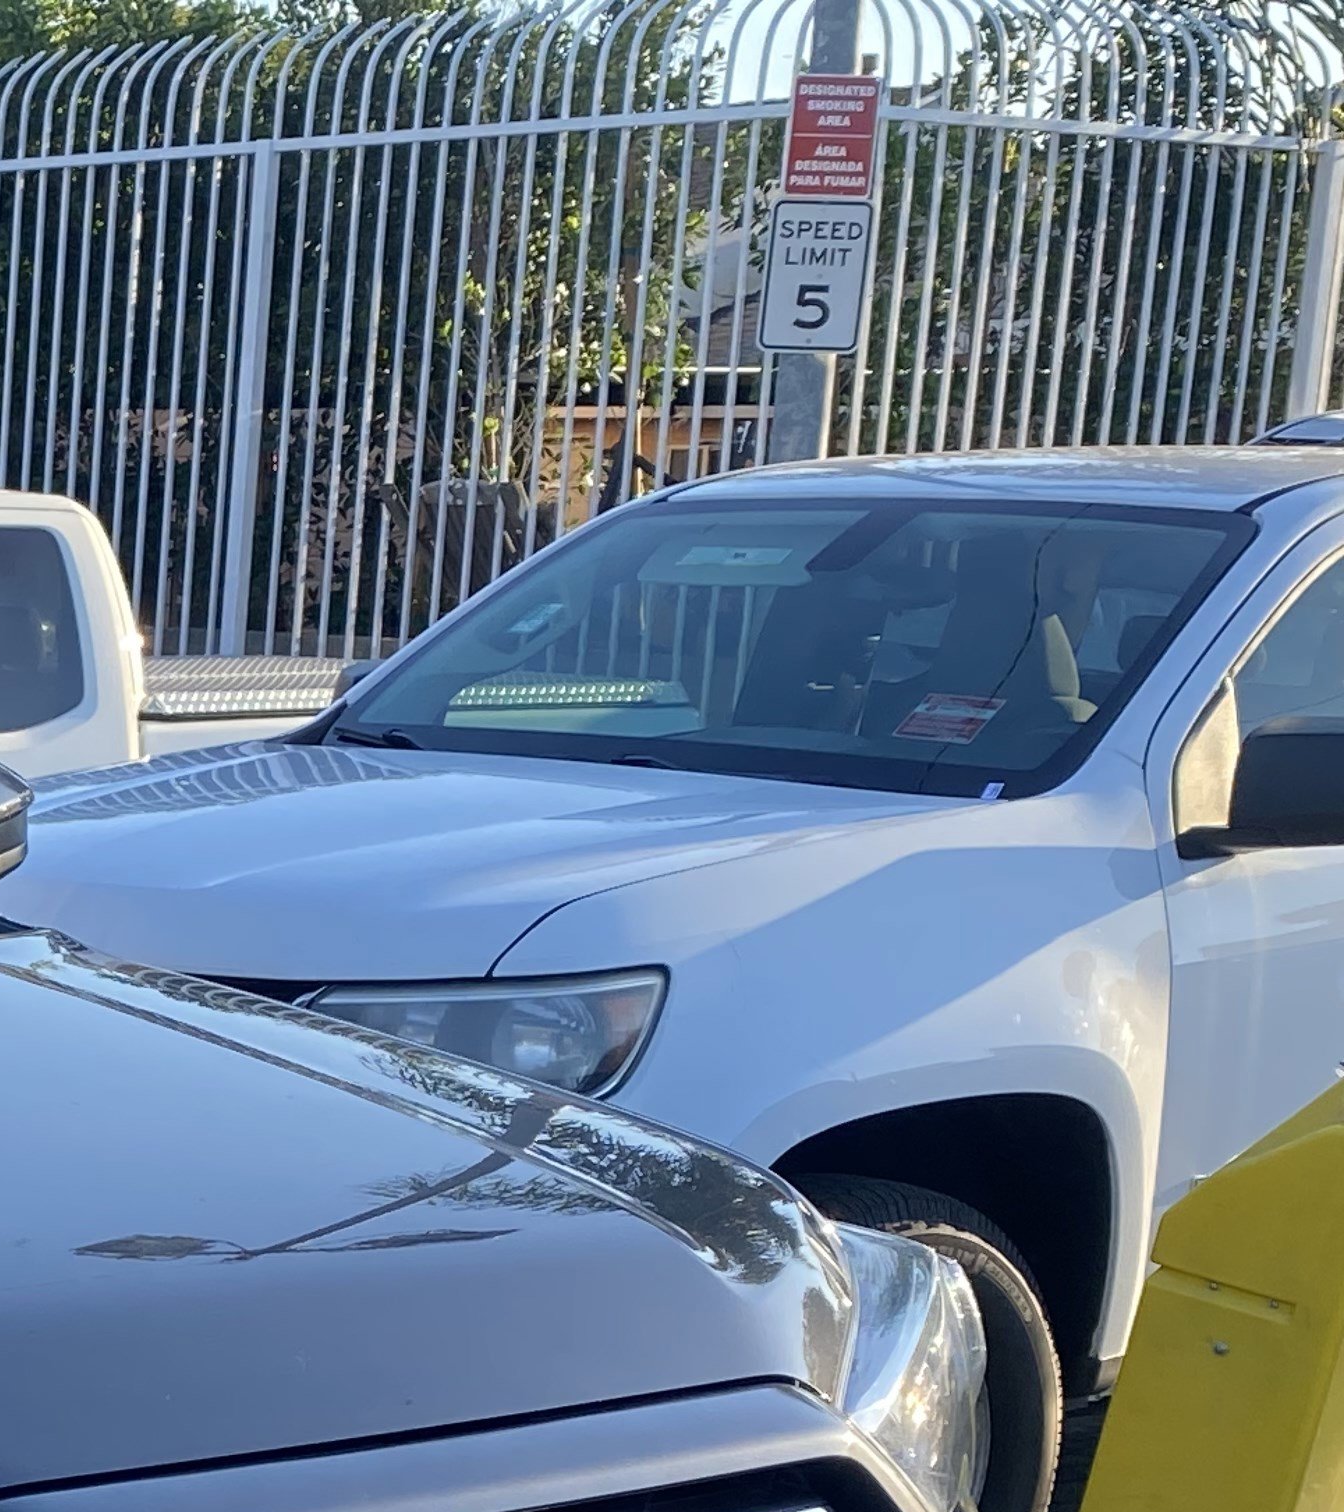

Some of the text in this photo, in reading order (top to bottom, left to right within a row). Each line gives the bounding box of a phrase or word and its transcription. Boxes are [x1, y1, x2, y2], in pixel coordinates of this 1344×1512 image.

[799, 84, 877, 97] DESIGNATED
[807, 99, 865, 112] SMOKING
[816, 115, 852, 127] AREA
[794, 160, 864, 172] DESIGNADA
[789, 174, 866, 187] PARA FUMAR
[779, 219, 863, 242] SPEED
[784, 246, 852, 268] LIMIT
[792, 284, 832, 330] 5
